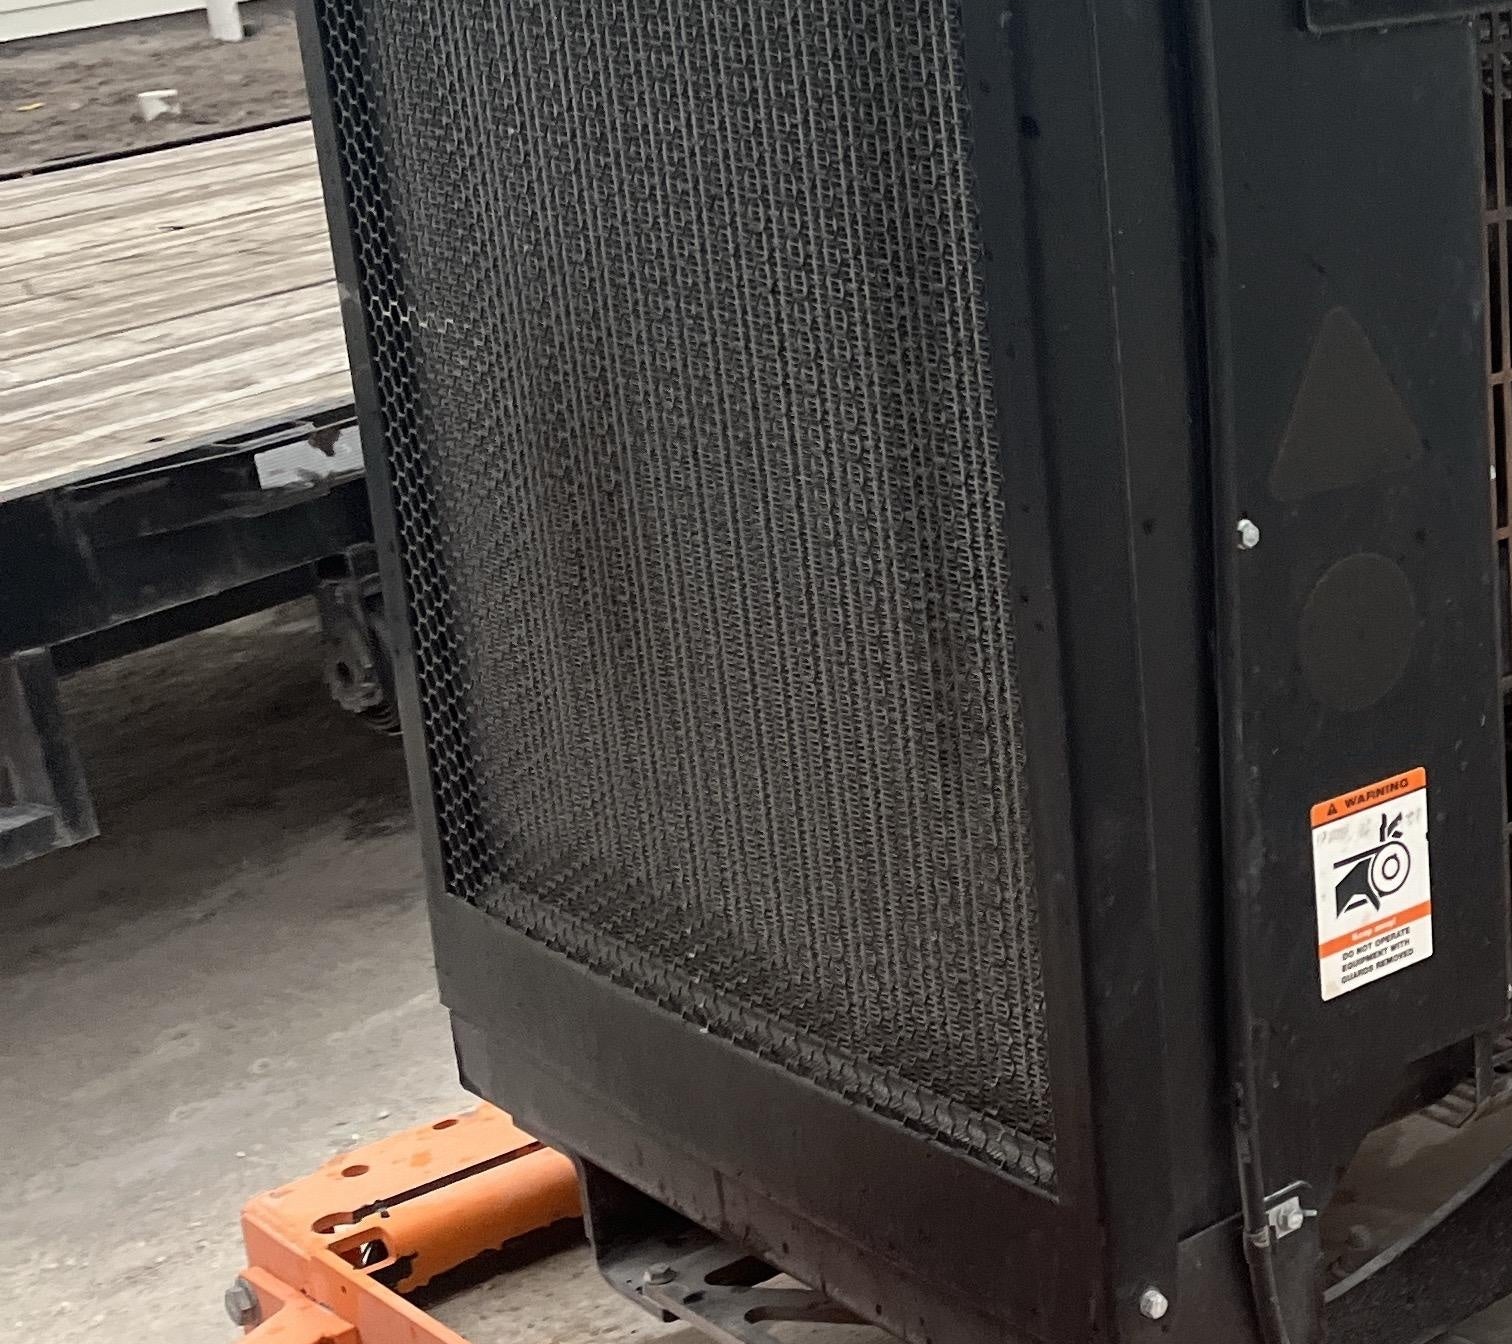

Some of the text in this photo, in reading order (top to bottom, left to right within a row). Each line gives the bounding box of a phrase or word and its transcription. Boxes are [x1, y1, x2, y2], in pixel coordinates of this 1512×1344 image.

[1344, 778, 1409, 809] WARNING
[1342, 950, 1355, 961] DO
[1356, 942, 1373, 955] NOT
[1374, 926, 1411, 947] OPERATE
[1342, 938, 1411, 973] EQUIPMENT WITH
[1341, 948, 1415, 984] GUARDS REMOVED
